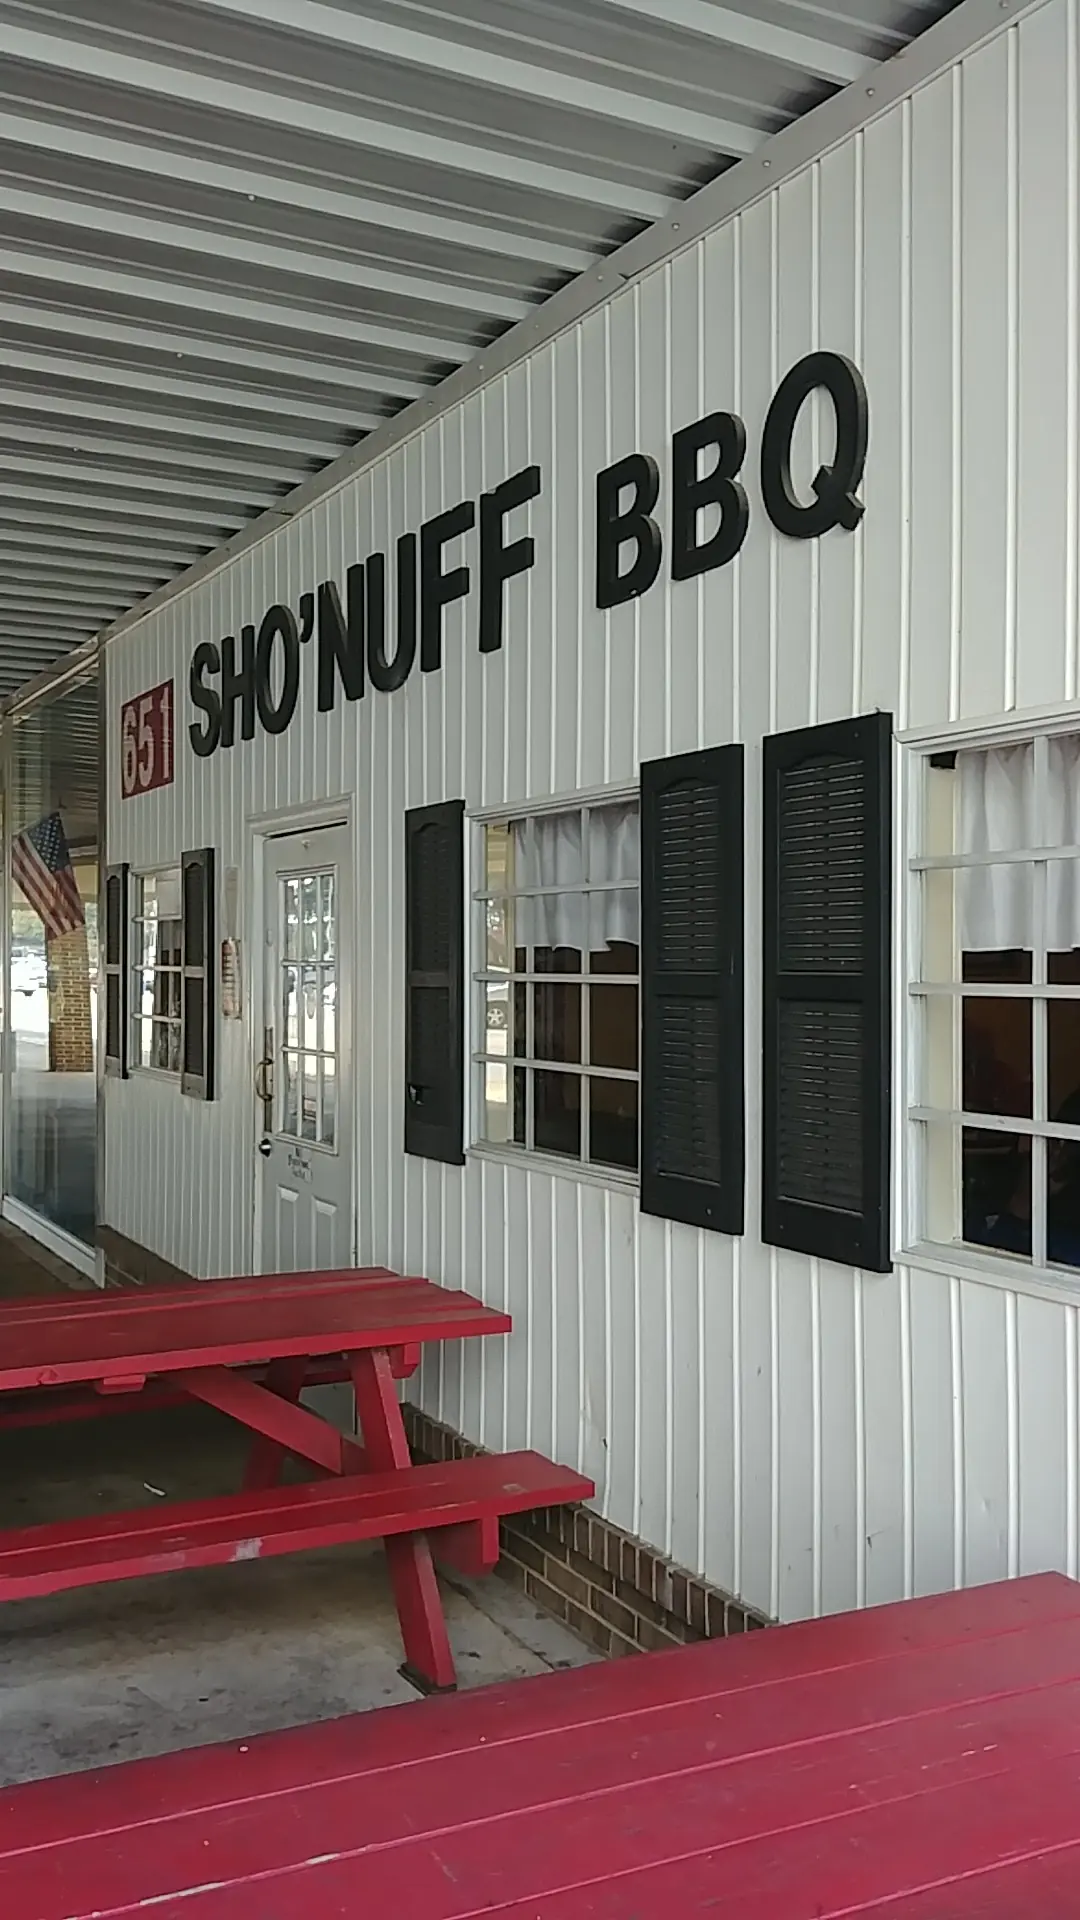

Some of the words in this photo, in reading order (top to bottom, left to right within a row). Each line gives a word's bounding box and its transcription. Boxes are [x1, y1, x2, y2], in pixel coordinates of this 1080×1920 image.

[189, 465, 541, 757] SHO'NUFF
[596, 351, 868, 608] BBQ
[123, 686, 171, 794] 651
